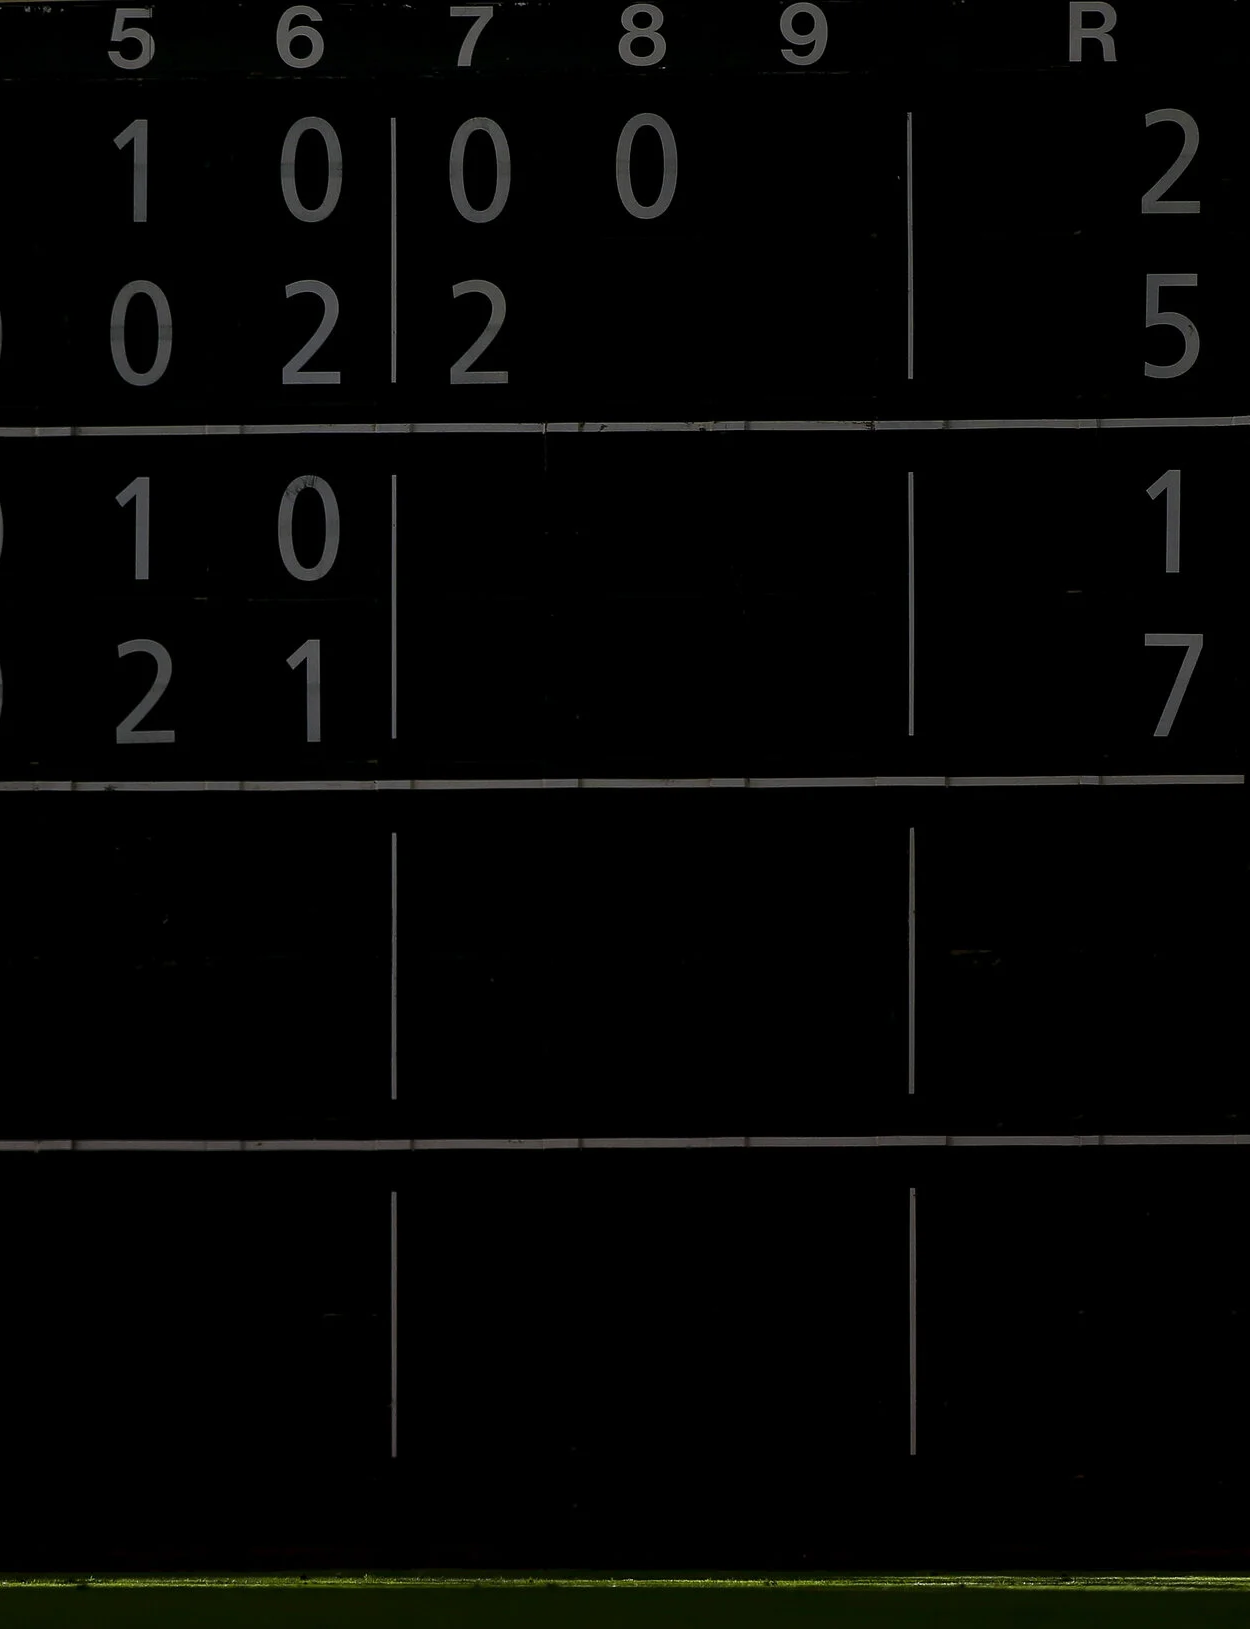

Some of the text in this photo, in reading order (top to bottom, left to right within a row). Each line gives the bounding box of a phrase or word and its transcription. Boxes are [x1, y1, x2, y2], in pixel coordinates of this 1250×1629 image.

[107, 7, 156, 70] 5
[276, 4, 325, 69] 6
[449, 5, 494, 67] 7
[618, 3, 667, 67] 8
[779, 1, 829, 66] 9
[1068, 1, 1118, 63] R
[113, 119, 148, 223] 1
[280, 116, 343, 223] 0
[449, 116, 511, 224] 0
[615, 112, 678, 220] 0
[1141, 107, 1201, 214] 2
[110, 279, 173, 387] 0
[282, 279, 341, 385] 2
[449, 279, 509, 385] 2
[1144, 273, 1201, 379] 5
[115, 476, 150, 580] 1
[277, 474, 340, 582] 0
[1145, 469, 1181, 574] 1
[116, 638, 176, 745] 2
[285, 639, 321, 743] 1
[1144, 633, 1204, 737] 7
